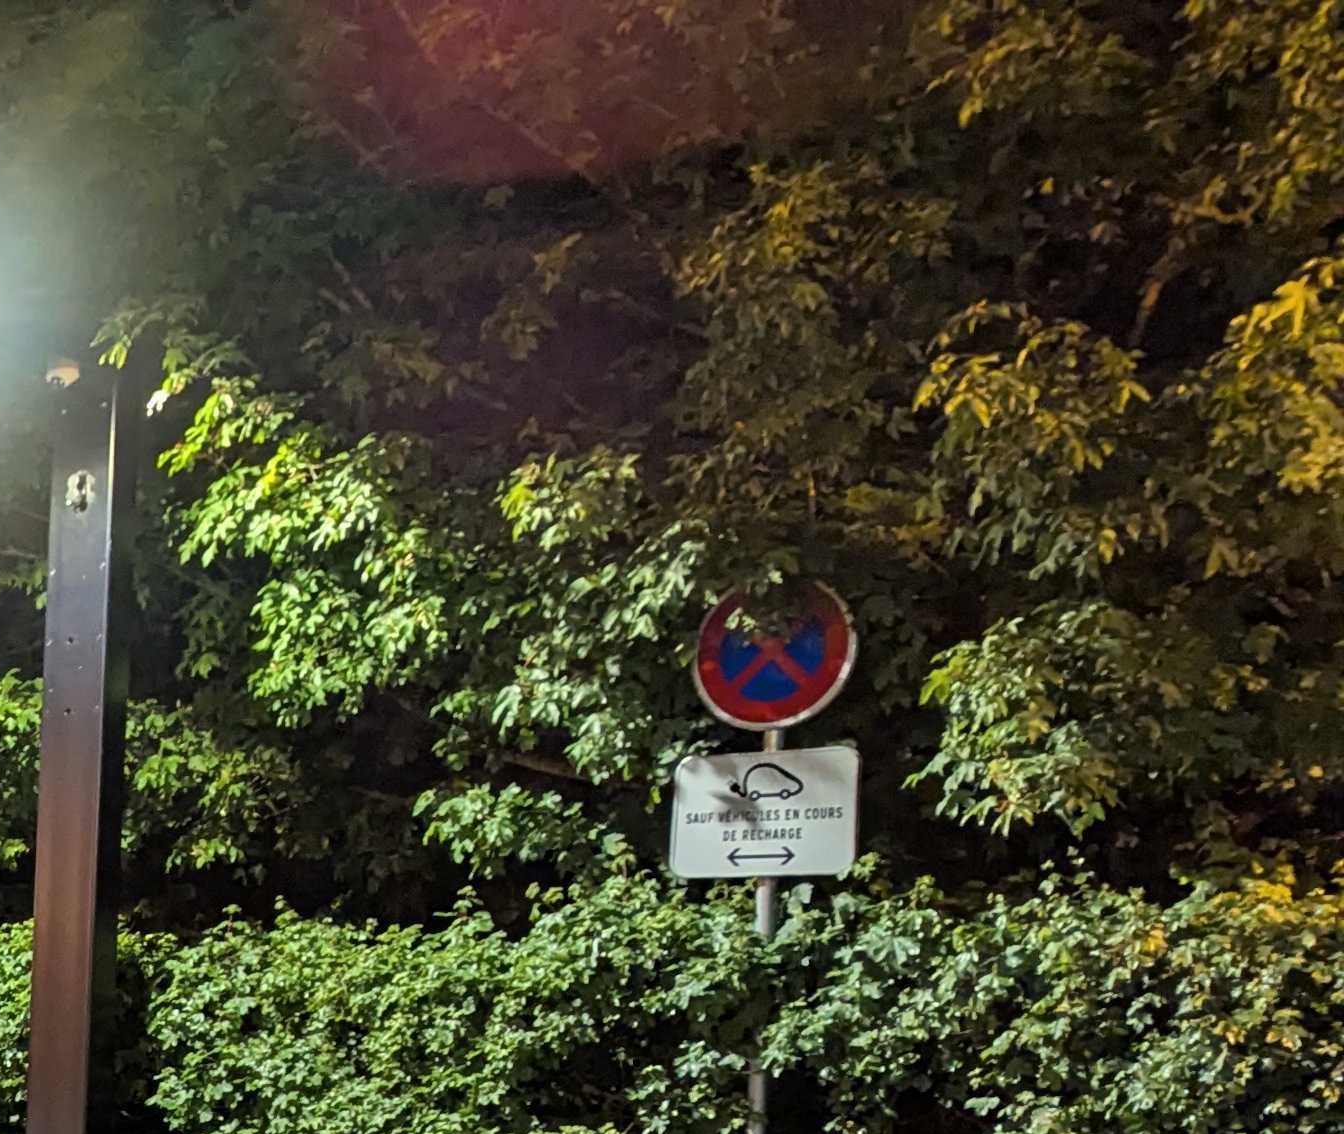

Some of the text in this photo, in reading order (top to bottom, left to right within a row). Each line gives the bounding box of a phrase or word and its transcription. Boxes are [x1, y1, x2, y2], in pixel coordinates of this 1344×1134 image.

[686, 812, 713, 824] SAUF
[785, 808, 800, 820] EN
[804, 806, 844, 819] COURS
[722, 827, 803, 842] DE RECHARGE
